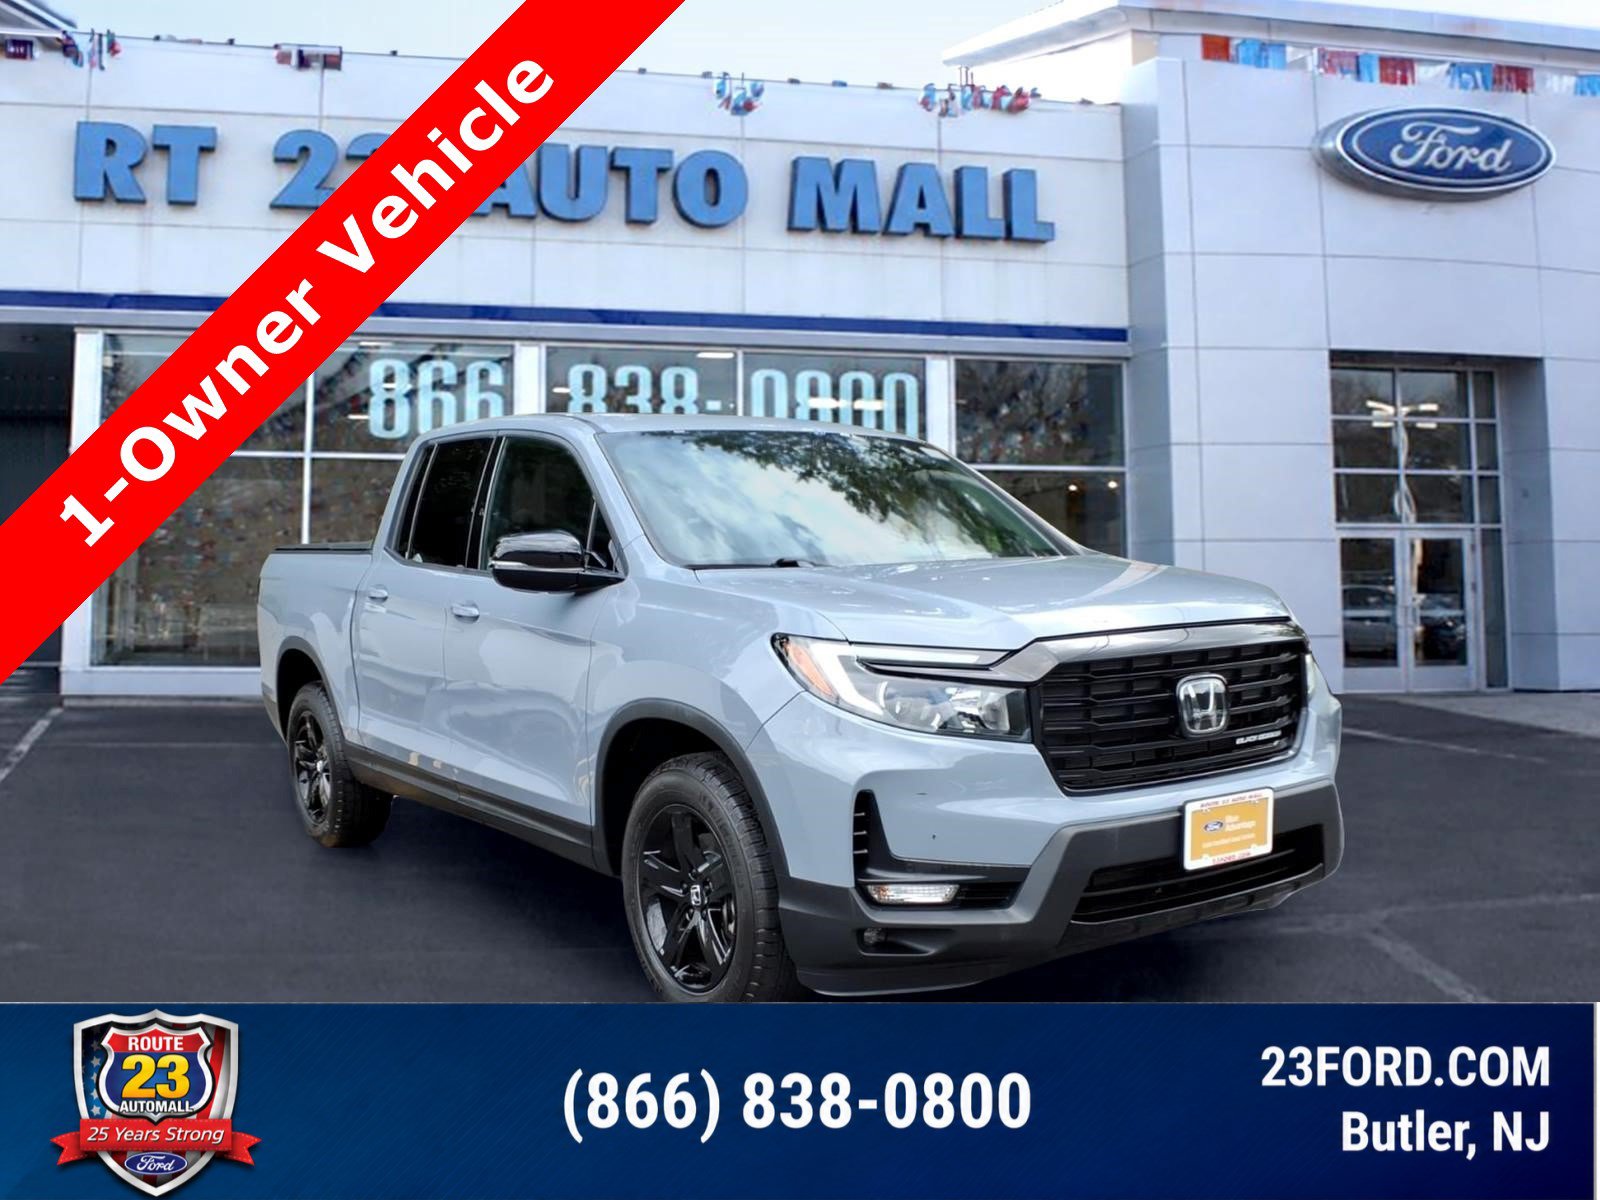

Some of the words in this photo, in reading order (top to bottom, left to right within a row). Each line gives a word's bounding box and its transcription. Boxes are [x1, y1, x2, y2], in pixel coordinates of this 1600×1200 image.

[74, 121, 217, 206] RT
[787, 157, 1055, 243] MALL
[1390, 122, 1512, 172] Ford
[369, 358, 503, 439] 866
